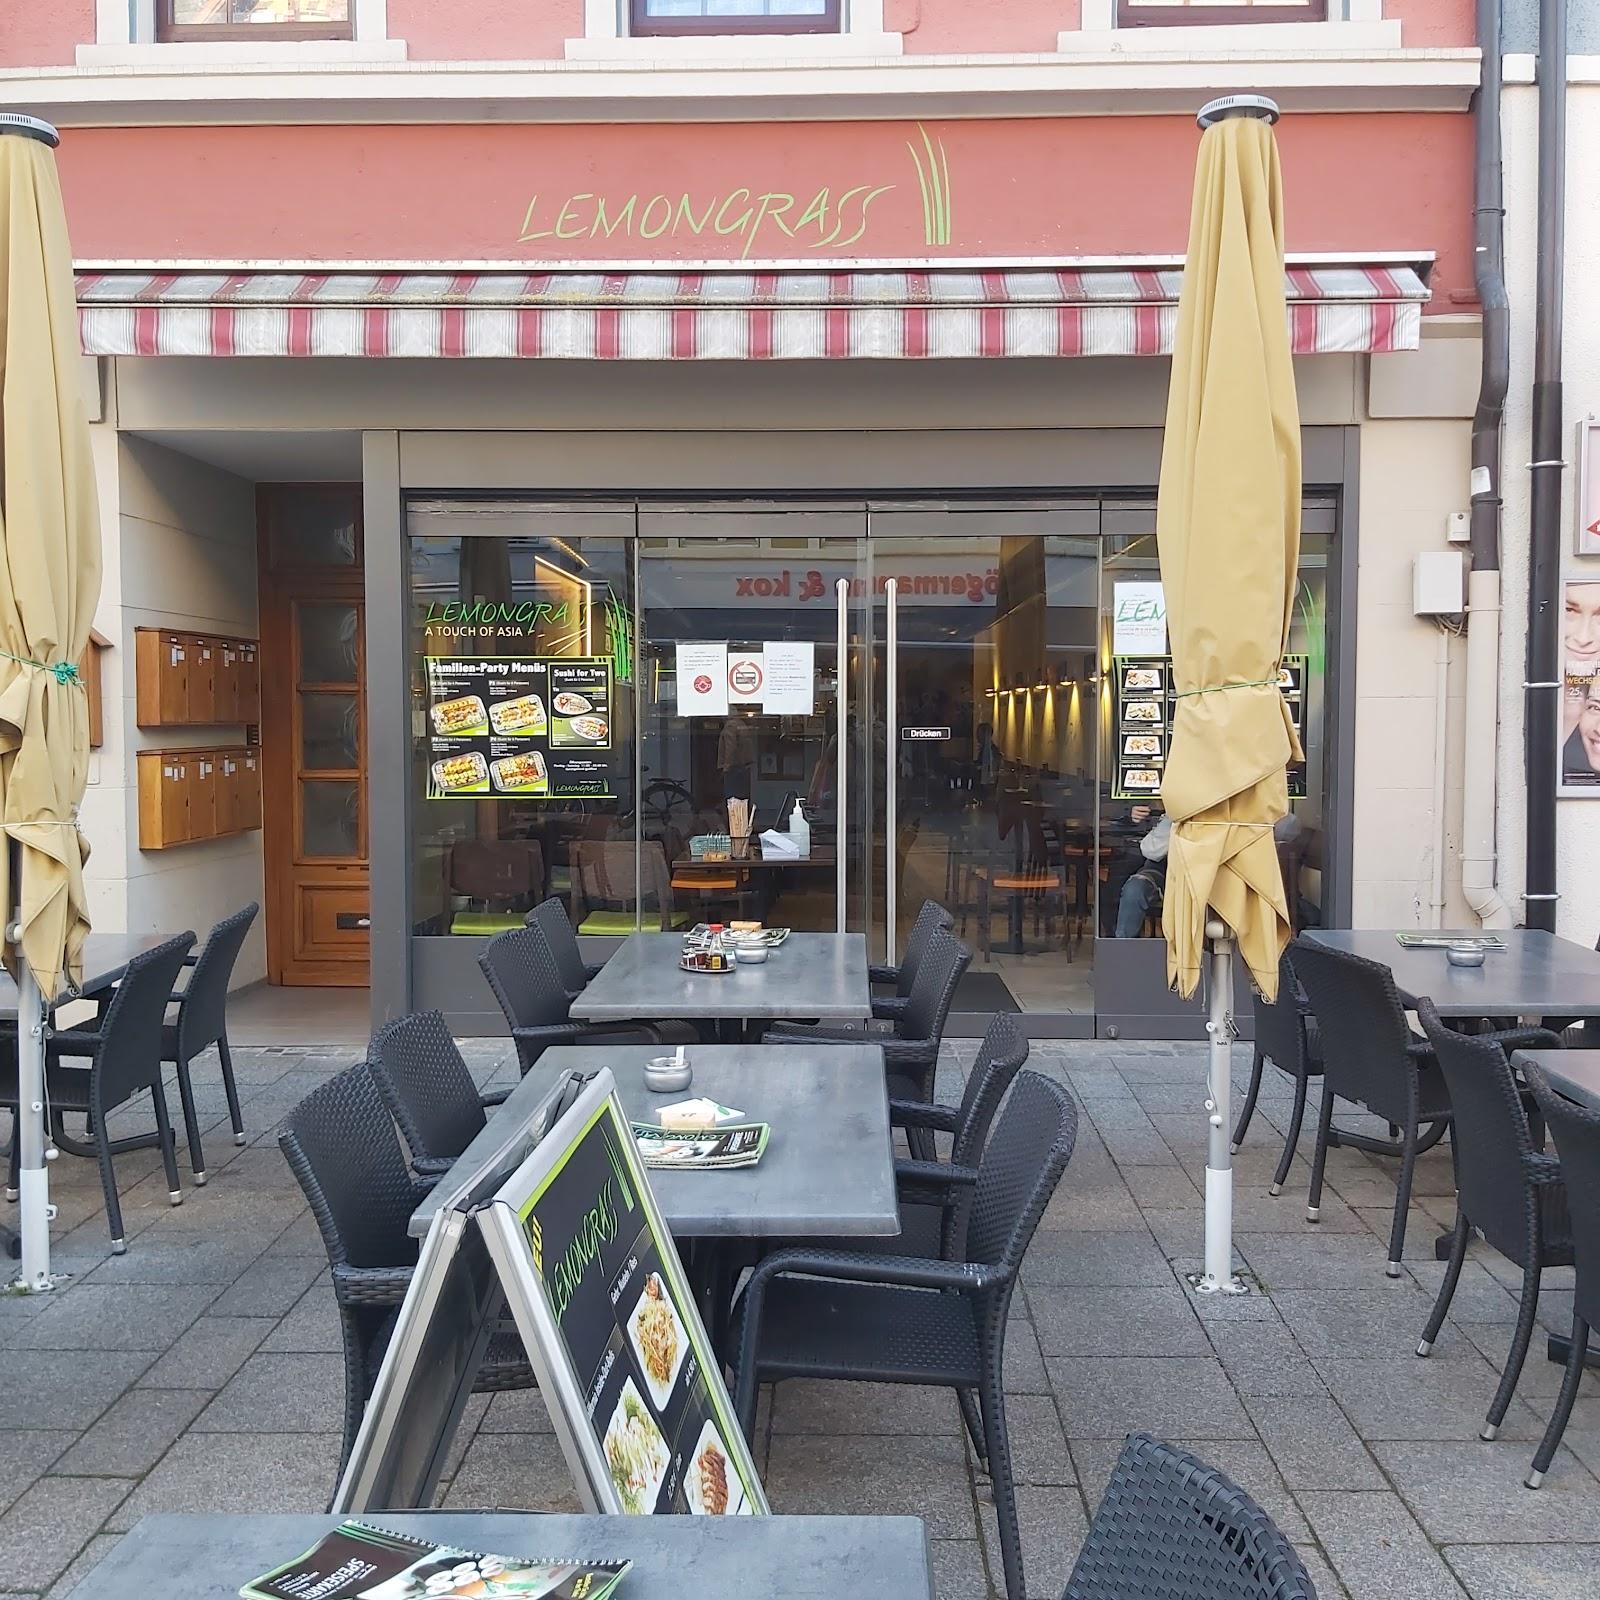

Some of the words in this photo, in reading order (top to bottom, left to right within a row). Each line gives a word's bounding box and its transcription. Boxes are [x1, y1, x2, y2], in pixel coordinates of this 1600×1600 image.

[517, 185, 897, 260] LEMONGRASS
[424, 627, 433, 637] A
[435, 627, 477, 637] TOUCH
[479, 627, 495, 637] OF
[497, 627, 523, 637] ASIA
[429, 662, 509, 675] Familien-Party
[512, 662, 547, 674] Menüs
[554, 668, 575, 678] Sushi
[577, 668, 588, 678] for
[589, 668, 606, 678] Two
[910, 729, 942, 739] Drücken
[547, 1176, 618, 1329] LEMONGRASS
[296, 1556, 365, 1600] SPEISEKARTE
